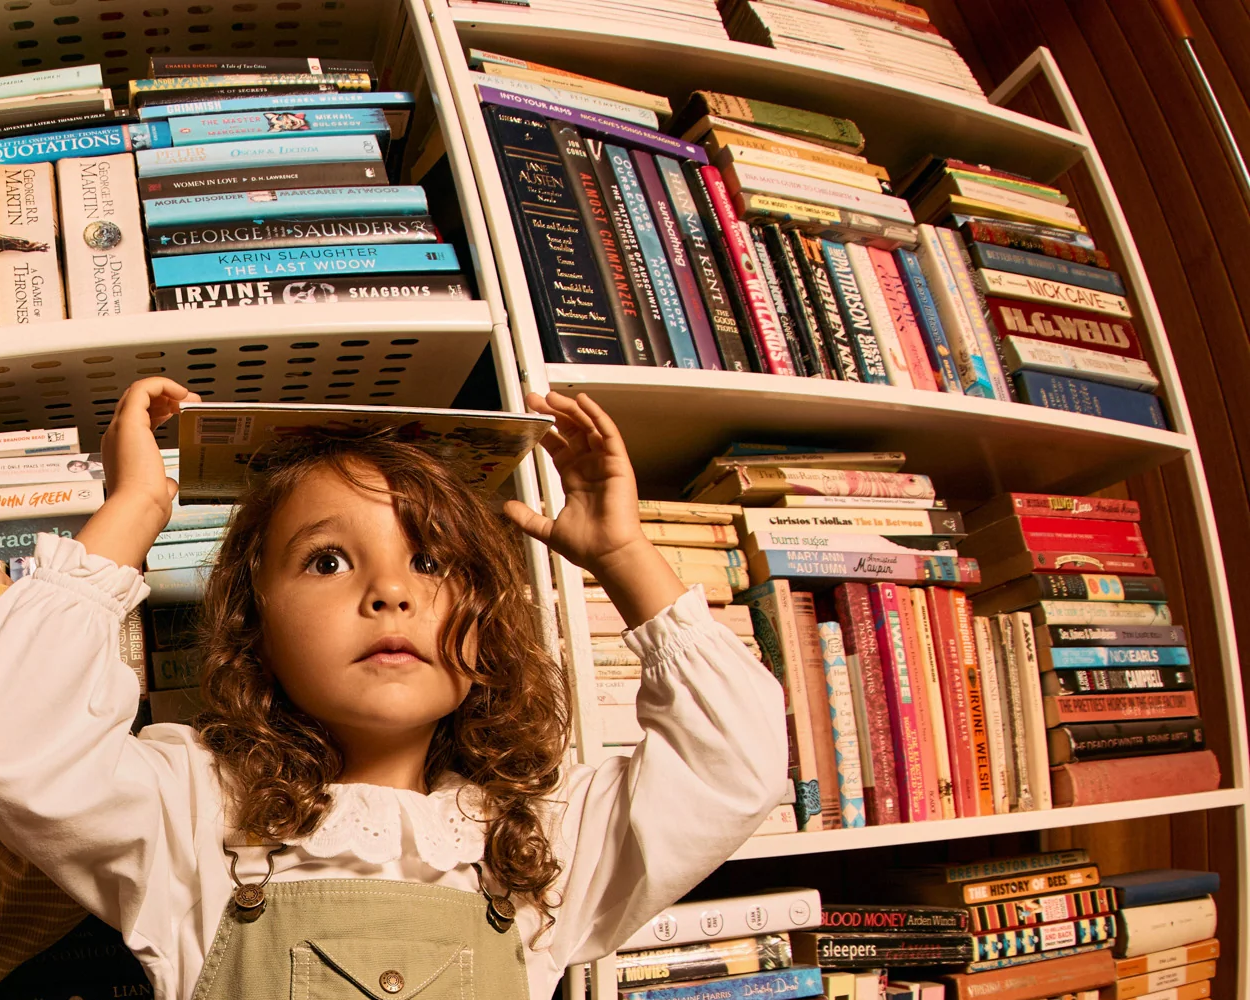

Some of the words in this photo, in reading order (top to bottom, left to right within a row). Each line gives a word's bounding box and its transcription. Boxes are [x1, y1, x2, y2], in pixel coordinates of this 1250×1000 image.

[548, 104, 572, 116] ARMS
[173, 179, 207, 188] WOMEN
[217, 177, 238, 186] LOVE
[519, 171, 564, 189] AUSTEN
[5, 169, 23, 226] MARTIN
[80, 162, 99, 219] MARTIN
[154, 196, 192, 206] MORAL
[195, 193, 244, 203] DISORDER
[279, 188, 343, 197] MARGARET
[172, 227, 262, 246] GEORGE
[294, 221, 410, 238] SAUNDERS
[658, 201, 686, 267] sunbathing
[218, 252, 272, 265] KARIN
[278, 248, 378, 261] SLAUGHTER
[224, 265, 262, 276] THE
[264, 262, 304, 273] LAST
[315, 259, 377, 271] WIDOW
[601, 230, 637, 318] CHIMPANZEE
[699, 254, 725, 304] KENT
[14, 262, 29, 324] THRONES
[175, 282, 272, 302] IRVINE
[349, 286, 432, 298] SKAGBOYS
[836, 246, 870, 331] PATTERSON
[1027, 279, 1063, 302] NICK
[1064, 286, 1104, 307] CAVE
[746, 280, 782, 361] WETLANDS
[29, 489, 73, 506] GREEN
[769, 516, 811, 526] Christos
[812, 516, 852, 526] Tsiolkas
[884, 517, 923, 526] Between
[770, 533, 798, 545] burnt
[801, 536, 829, 548] sugar
[787, 551, 817, 562] MARY
[821, 552, 845, 562] ANN
[796, 563, 848, 575] AUTUMN
[1126, 670, 1163, 687] CAMPBELL
[969, 691, 984, 736] IRVINE
[977, 742, 990, 793] WELSH
[984, 860, 1029, 877] EASTON
[968, 885, 988, 899] THE
[990, 880, 1029, 896] HISTORY
[865, 911, 907, 928] MONEY
[907, 915, 931, 926] Arden
[933, 914, 956, 926] Winch
[822, 942, 878, 958] sleepers
